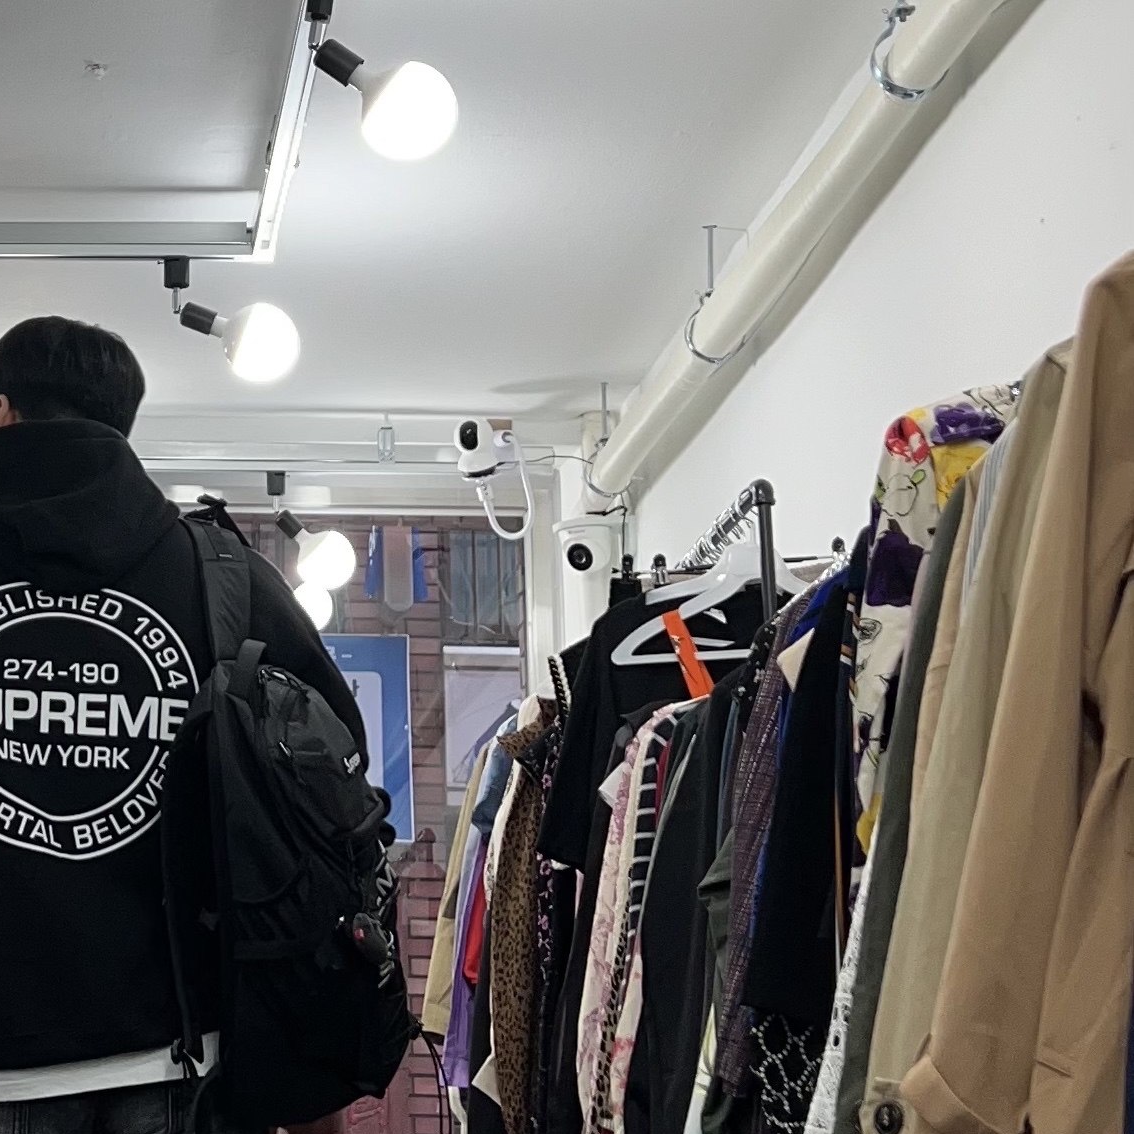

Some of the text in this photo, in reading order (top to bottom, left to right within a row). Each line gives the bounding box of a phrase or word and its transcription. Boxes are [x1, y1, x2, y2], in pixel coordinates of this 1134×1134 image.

[133, 617, 189, 690] 1994
[3, 658, 120, 685] 274-190
[56, 744, 130, 770] YORK
